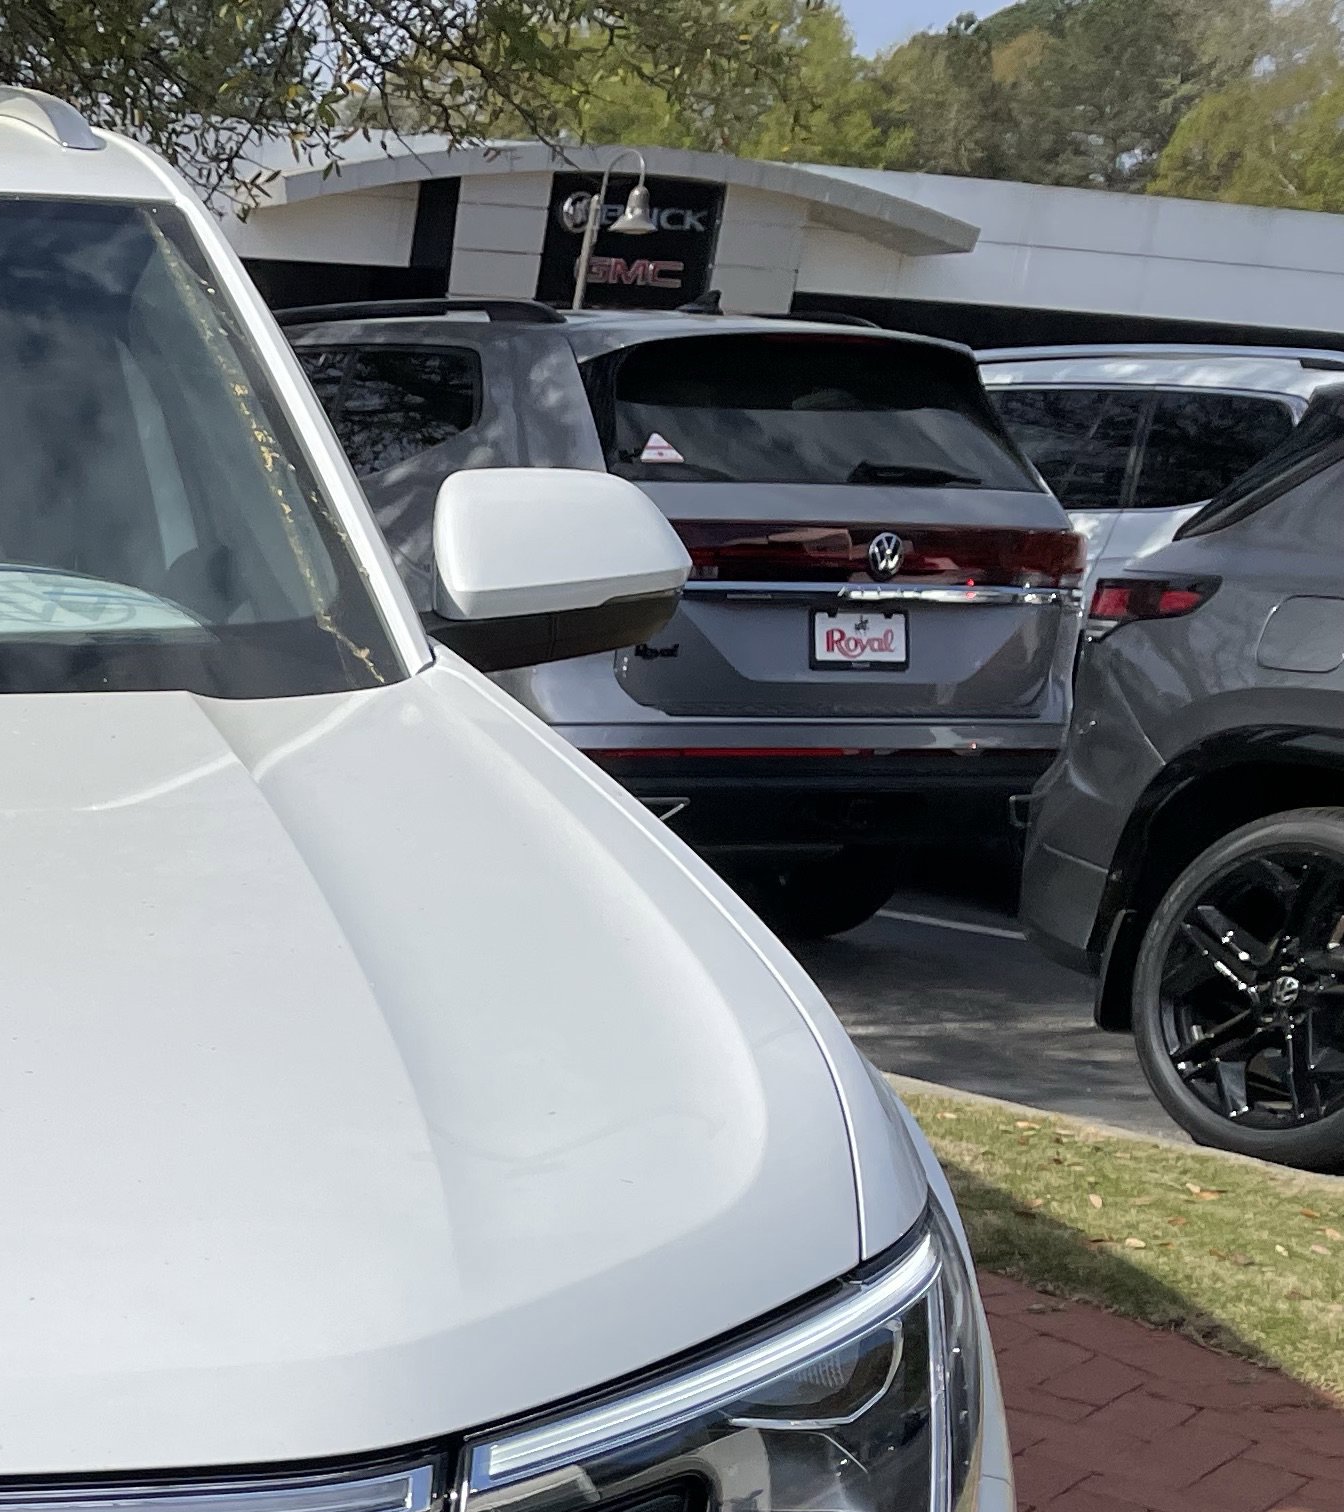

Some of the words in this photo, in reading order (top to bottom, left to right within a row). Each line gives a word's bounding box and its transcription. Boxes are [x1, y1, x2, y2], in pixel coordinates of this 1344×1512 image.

[600, 203, 707, 232] BICK
[574, 256, 684, 288] GMC
[826, 628, 895, 659] Royal
